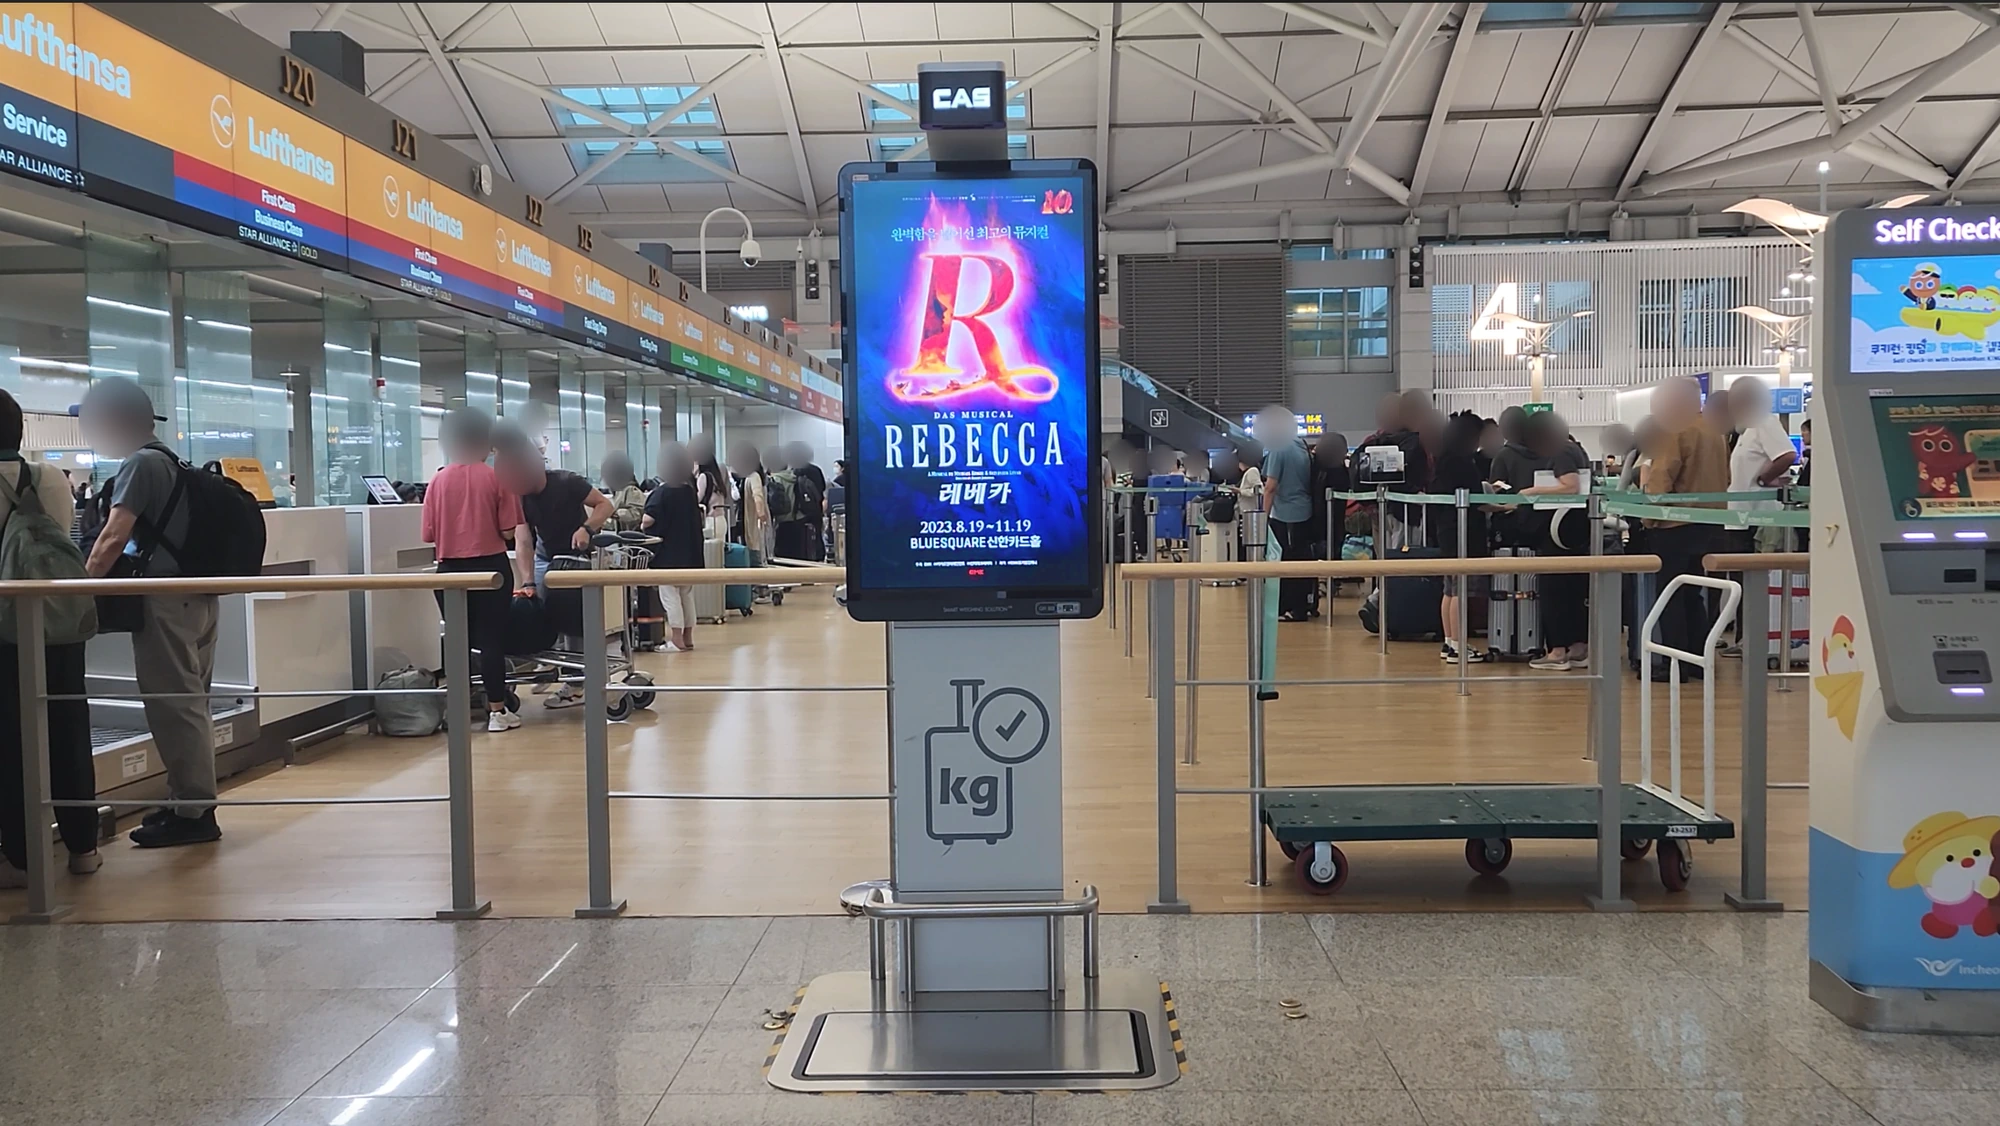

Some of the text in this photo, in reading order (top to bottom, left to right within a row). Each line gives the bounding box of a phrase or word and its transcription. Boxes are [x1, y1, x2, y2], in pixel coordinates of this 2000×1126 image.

[0, 13, 132, 99] ufthansa
[279, 56, 316, 107] J20
[932, 87, 991, 110] CAS
[3, 103, 68, 148] Service
[248, 116, 335, 186] Lufthansa
[18, 155, 73, 184] ALLIANCE
[261, 189, 296, 213] First Class
[406, 190, 463, 240] Lufthansa
[254, 209, 303, 238] Business Class
[890, 226, 938, 242] 완벽함을
[976, 225, 1012, 240] 최고의
[1013, 224, 1050, 240] 뮤지컬
[1875, 216, 2000, 242] Self Check
[238, 225, 318, 259] STAR ALLIANCE GOLD
[511, 239, 552, 278] Lufthansa
[1470, 282, 1527, 355] 4
[933, 410, 1014, 420] DAS MUSICAL
[884, 422, 1065, 468] REBECCA
[939, 482, 1012, 505] 레베카
[910, 535, 1042, 550] BLUESQUARE 신한카드홀
[939, 767, 999, 817] kg
